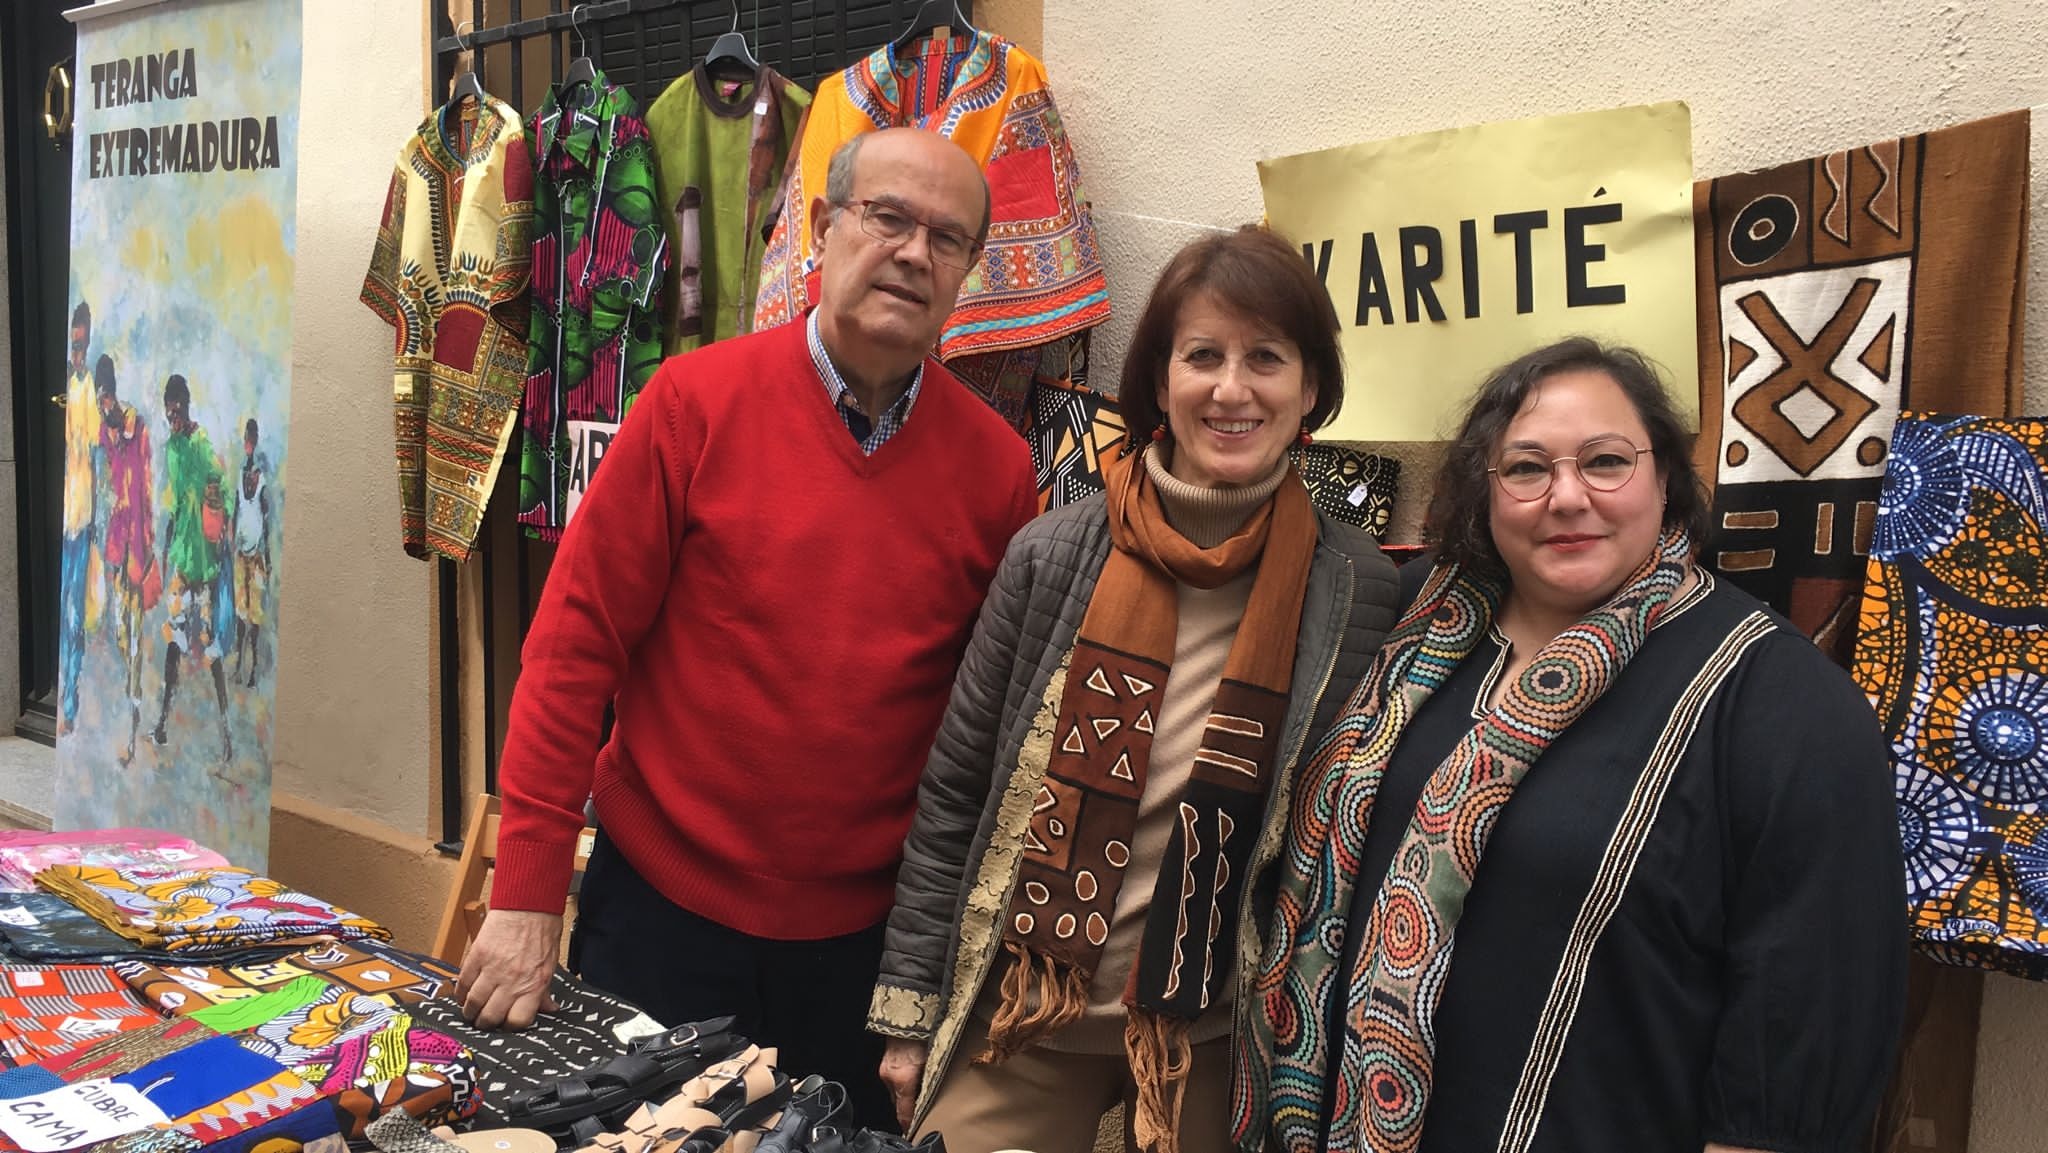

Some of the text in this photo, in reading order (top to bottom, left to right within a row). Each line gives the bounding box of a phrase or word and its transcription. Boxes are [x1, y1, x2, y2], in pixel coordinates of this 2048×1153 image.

[90, 48, 198, 110] TERANGA
[89, 116, 281, 179] EXTREMADURA
[1302, 186, 1626, 332] KARITÉ
[9, 1101, 88, 1146] CAMA
[74, 1085, 139, 1123] CUBRE
